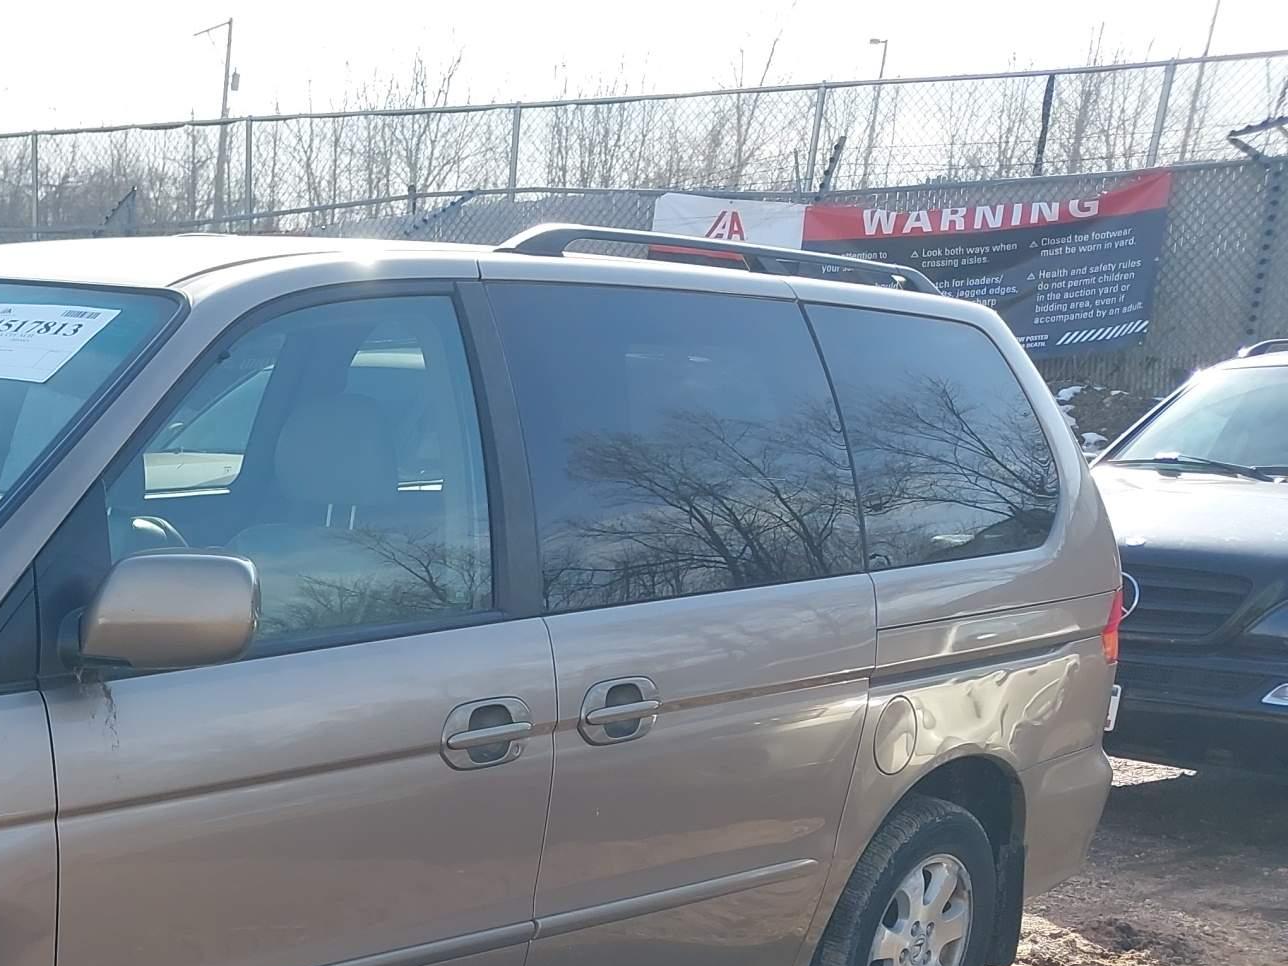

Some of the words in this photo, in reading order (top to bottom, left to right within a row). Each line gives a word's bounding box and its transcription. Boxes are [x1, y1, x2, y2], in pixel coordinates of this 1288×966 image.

[863, 199, 1100, 236] WARNING
[1041, 235, 1072, 246] Closed
[1074, 234, 1089, 242] toe
[1092, 227, 1132, 240] footwear
[841, 251, 878, 260] ttention
[879, 251, 888, 260] to
[922, 248, 943, 258] Look
[944, 246, 964, 256] both
[966, 245, 990, 255] ways
[992, 243, 1018, 252] when
[1040, 247, 1063, 257] must
[1065, 245, 1076, 254] be
[1079, 243, 1102, 253] worn
[1104, 240, 1113, 249] in
[1114, 237, 1136, 249] yard.
[821, 264, 840, 274] your
[921, 257, 959, 268] crossing
[1038, 268, 1068, 279] Health
[1070, 266, 1087, 276] and
[1089, 263, 1117, 275] safety
[1118, 259, 1142, 269] rules
[935, 279, 947, 289] tch
[952, 278, 965, 288] for
[966, 274, 1004, 286] loaders/
[1037, 281, 1049, 291] do
[1051, 280, 1066, 289] not
[1067, 277, 1096, 289] permit
[1098, 271, 1135, 283] children
[956, 287, 987, 298] jagged
[988, 285, 1019, 295] edges,
[1036, 293, 1045, 302] in
[1047, 291, 1061, 301] the
[1063, 287, 1096, 298] auction
[1098, 283, 1119, 295] yard
[1121, 284, 1130, 292] or
[1035, 302, 1068, 313] bidding
[1069, 301, 1093, 310] area,
[1095, 297, 1117, 306] even
[1118, 293, 1126, 302] if
[1033, 310, 1094, 324] accompanied
[1096, 308, 1107, 318] by
[1108, 307, 1120, 315] an
